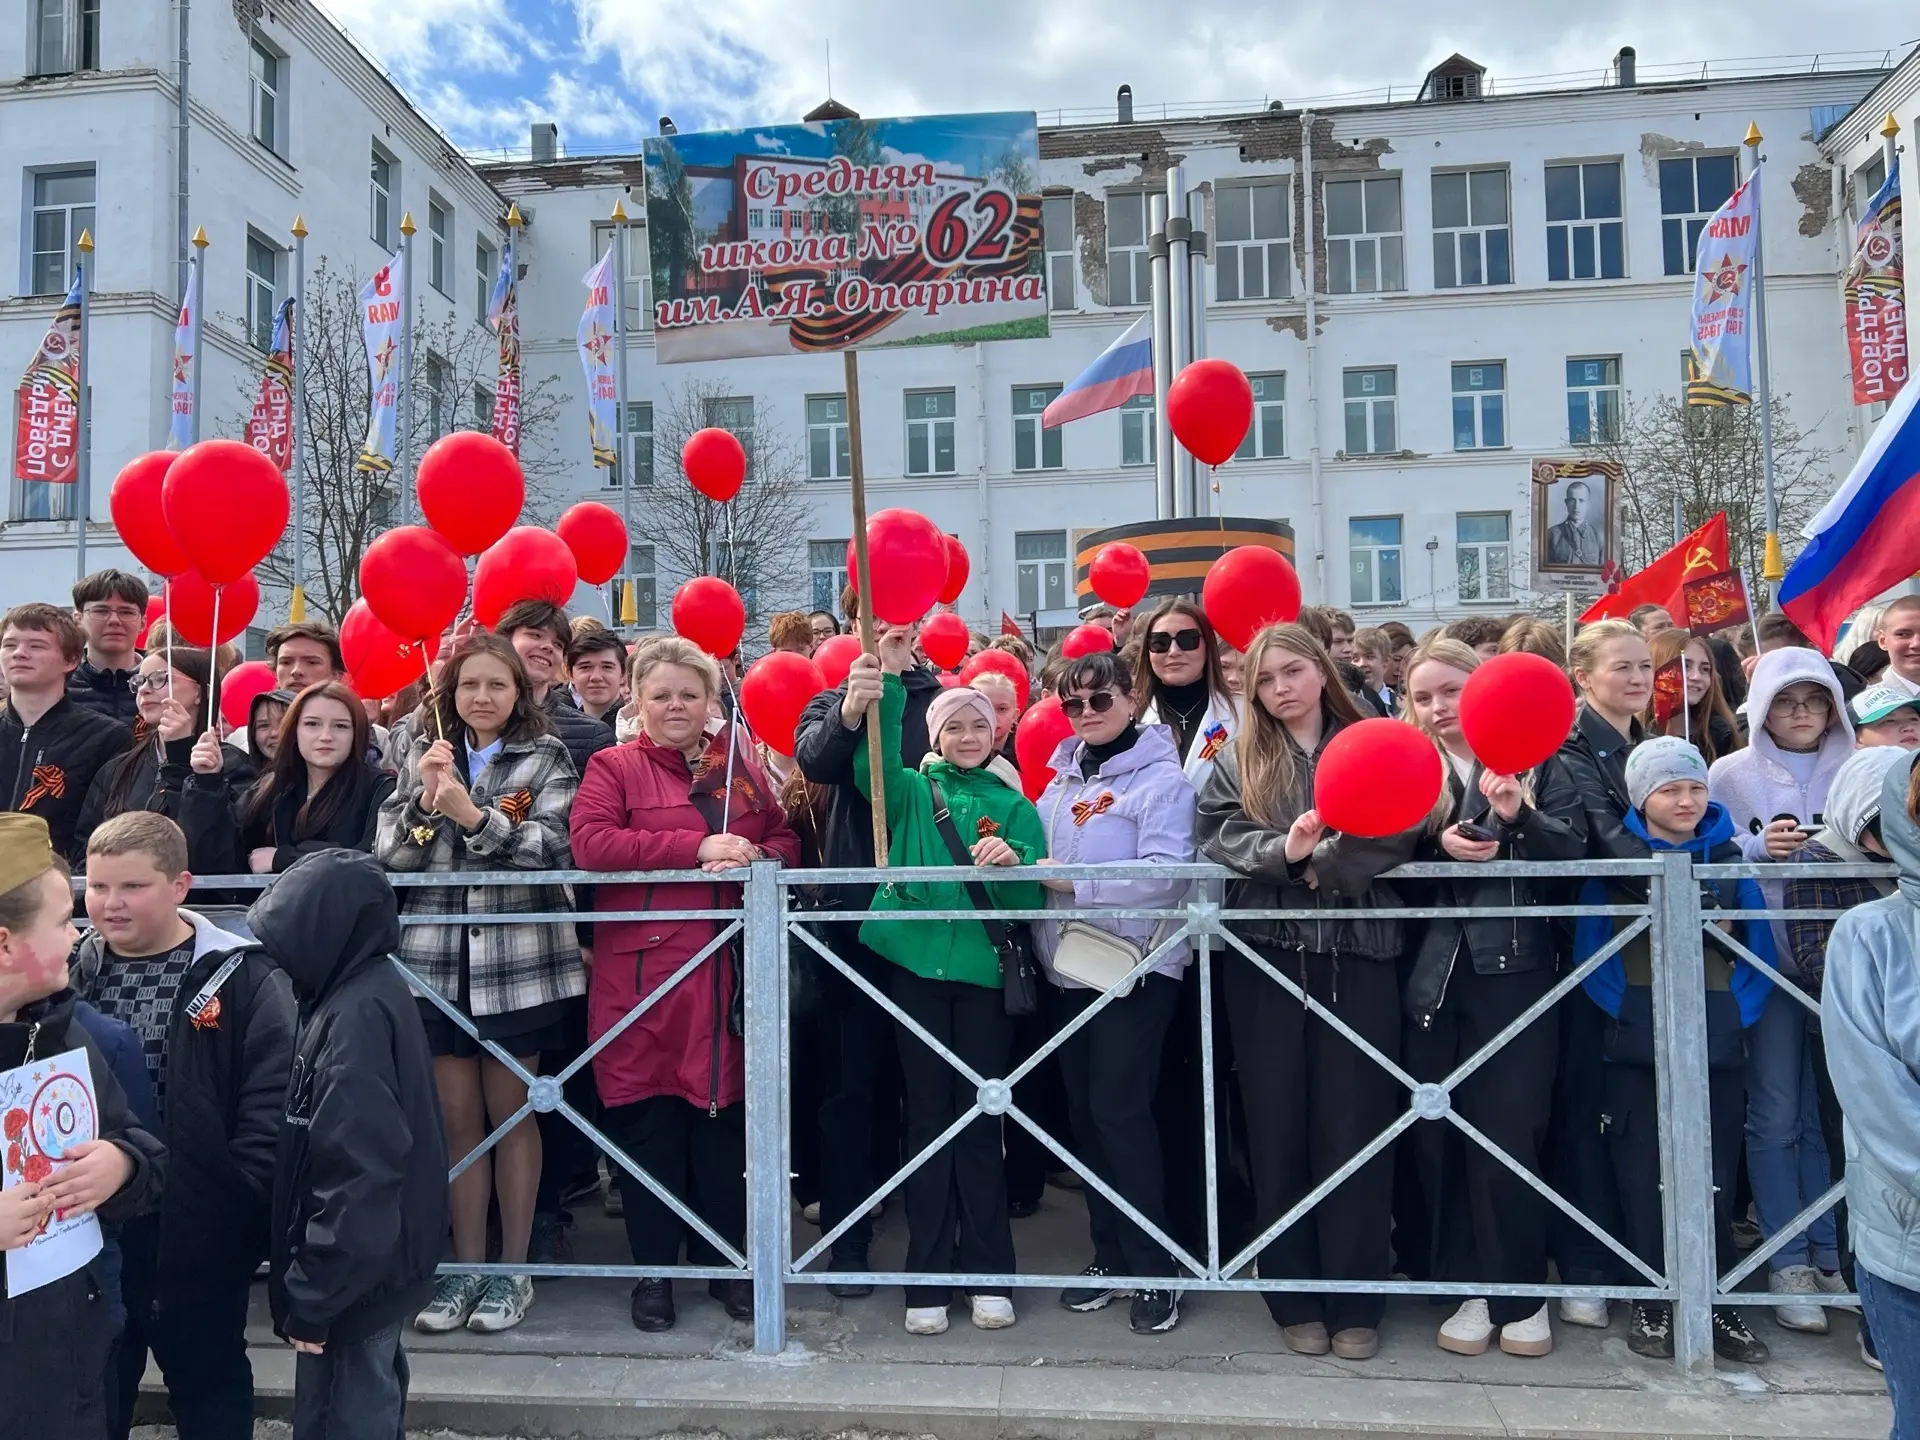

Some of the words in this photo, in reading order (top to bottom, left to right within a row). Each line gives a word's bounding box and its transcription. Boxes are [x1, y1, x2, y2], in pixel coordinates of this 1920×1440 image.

[745, 155, 936, 207] Средняя
[701, 235, 848, 271] школа
[860, 223, 916, 258] №
[925, 189, 1016, 266] 62
[834, 275, 1044, 316] Опарина
[1050, 575, 1058, 587] 9
[1356, 561, 1364, 573] 9
